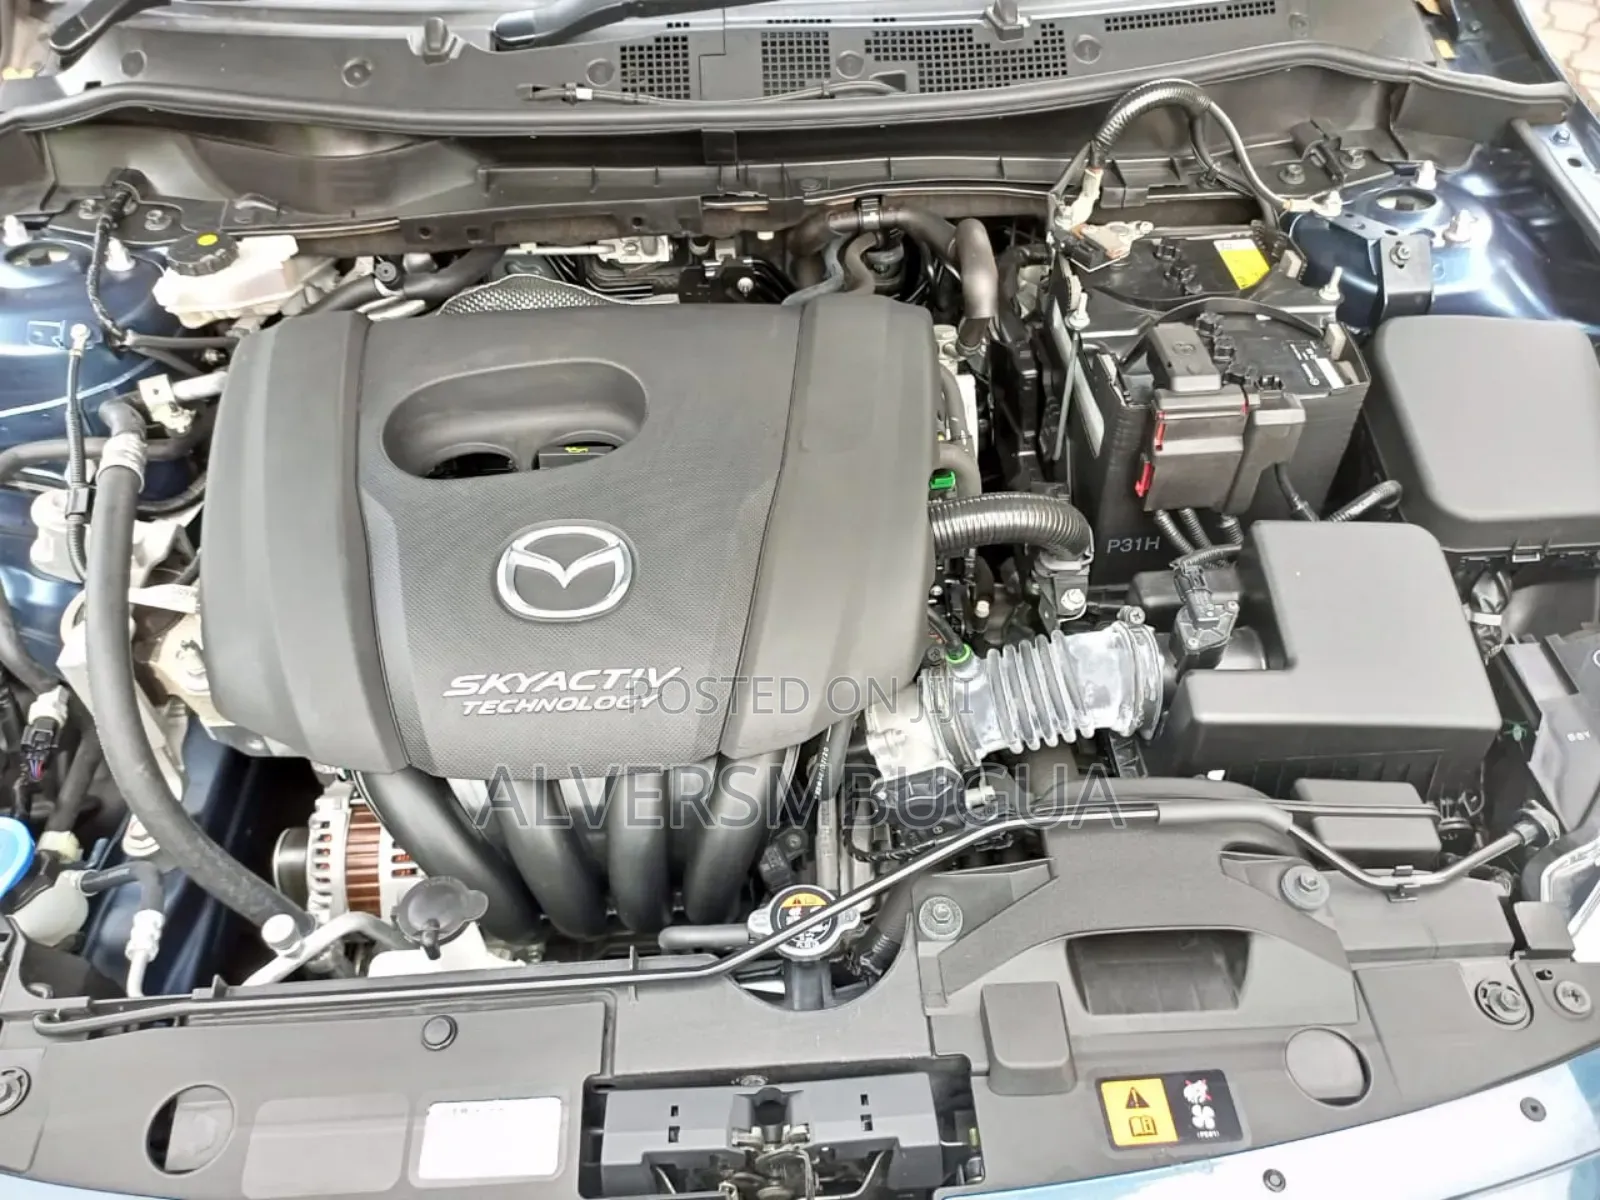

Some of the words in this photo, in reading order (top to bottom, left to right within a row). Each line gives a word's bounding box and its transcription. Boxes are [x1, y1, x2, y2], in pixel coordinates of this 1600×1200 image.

[1106, 536, 1160, 554] P31H
[443, 666, 683, 697] SKYACTIV
[461, 694, 662, 716] TECHNOLOGY
